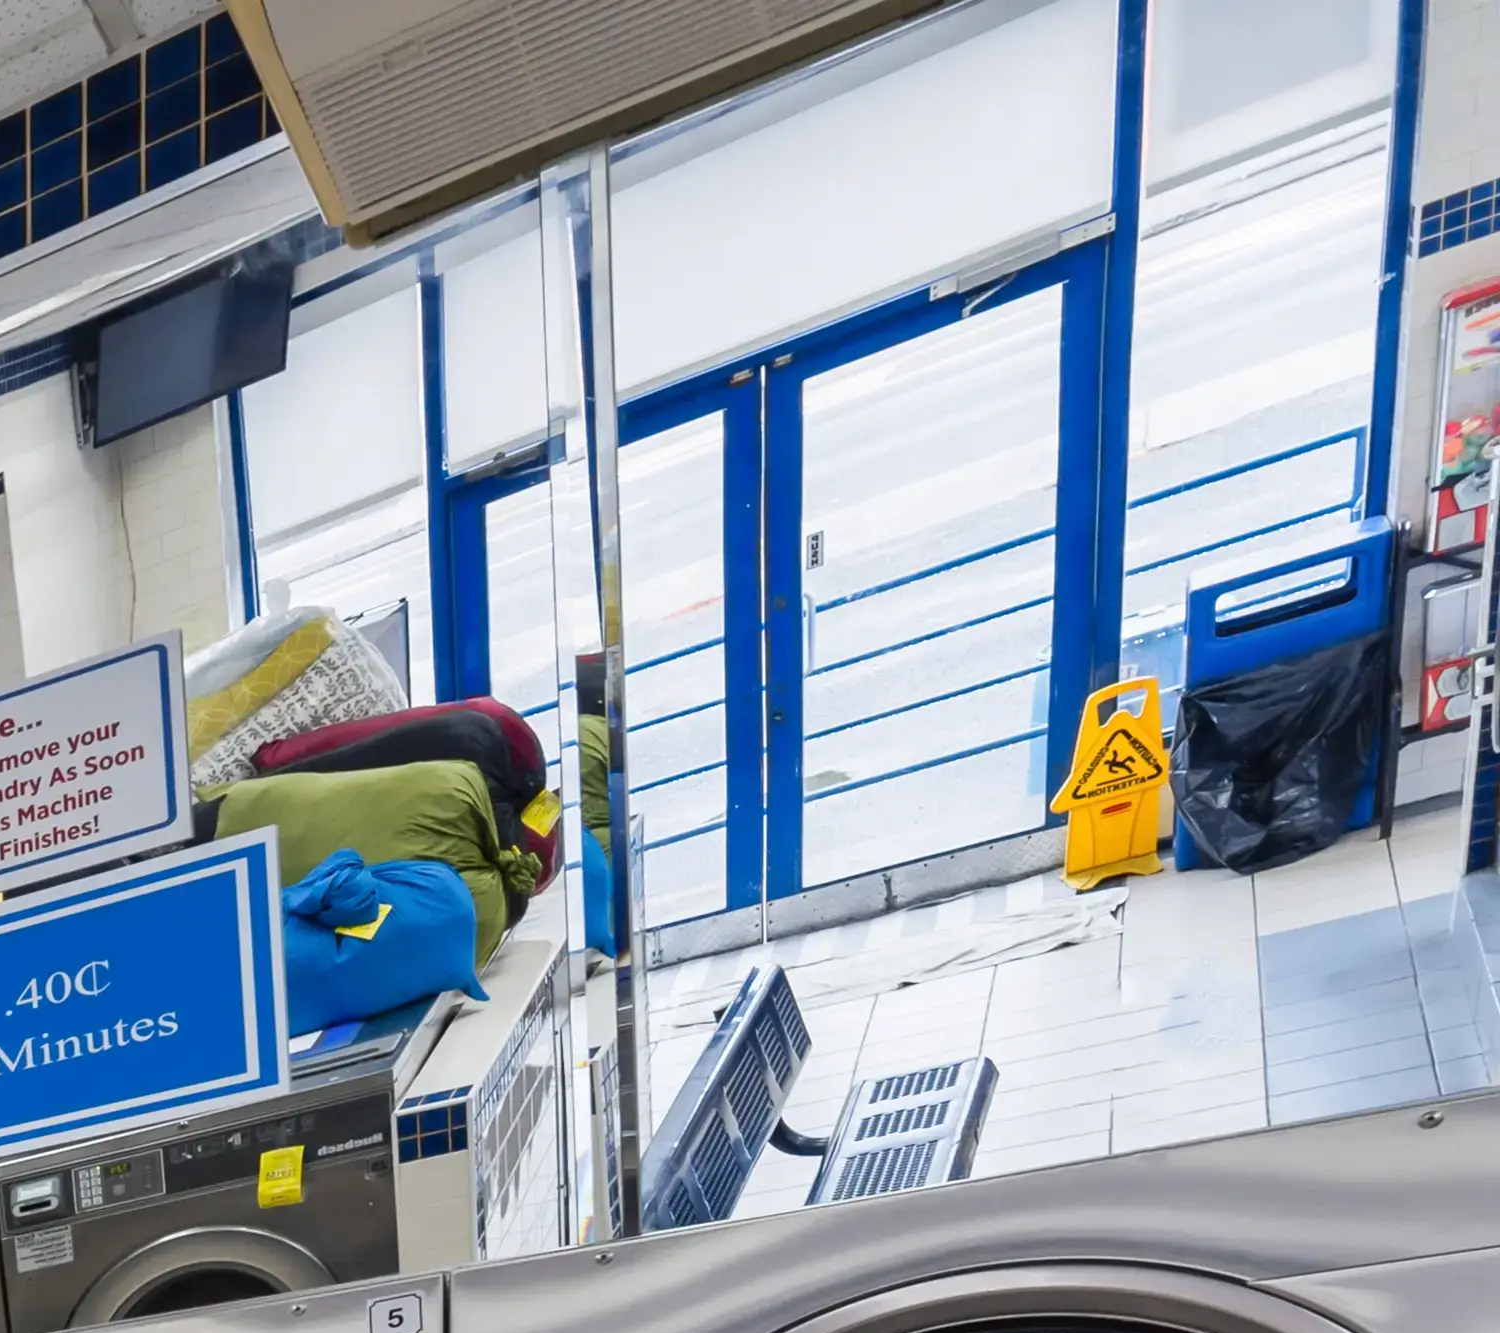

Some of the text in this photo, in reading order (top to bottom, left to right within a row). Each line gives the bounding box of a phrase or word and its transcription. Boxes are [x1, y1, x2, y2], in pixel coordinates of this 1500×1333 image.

[67, 720, 121, 755] your
[49, 766, 77, 787] As
[84, 744, 145, 776] Soon
[17, 785, 113, 827] Machine
[0, 815, 100, 861] Finishes!
[387, 1307, 404, 1329] 5
